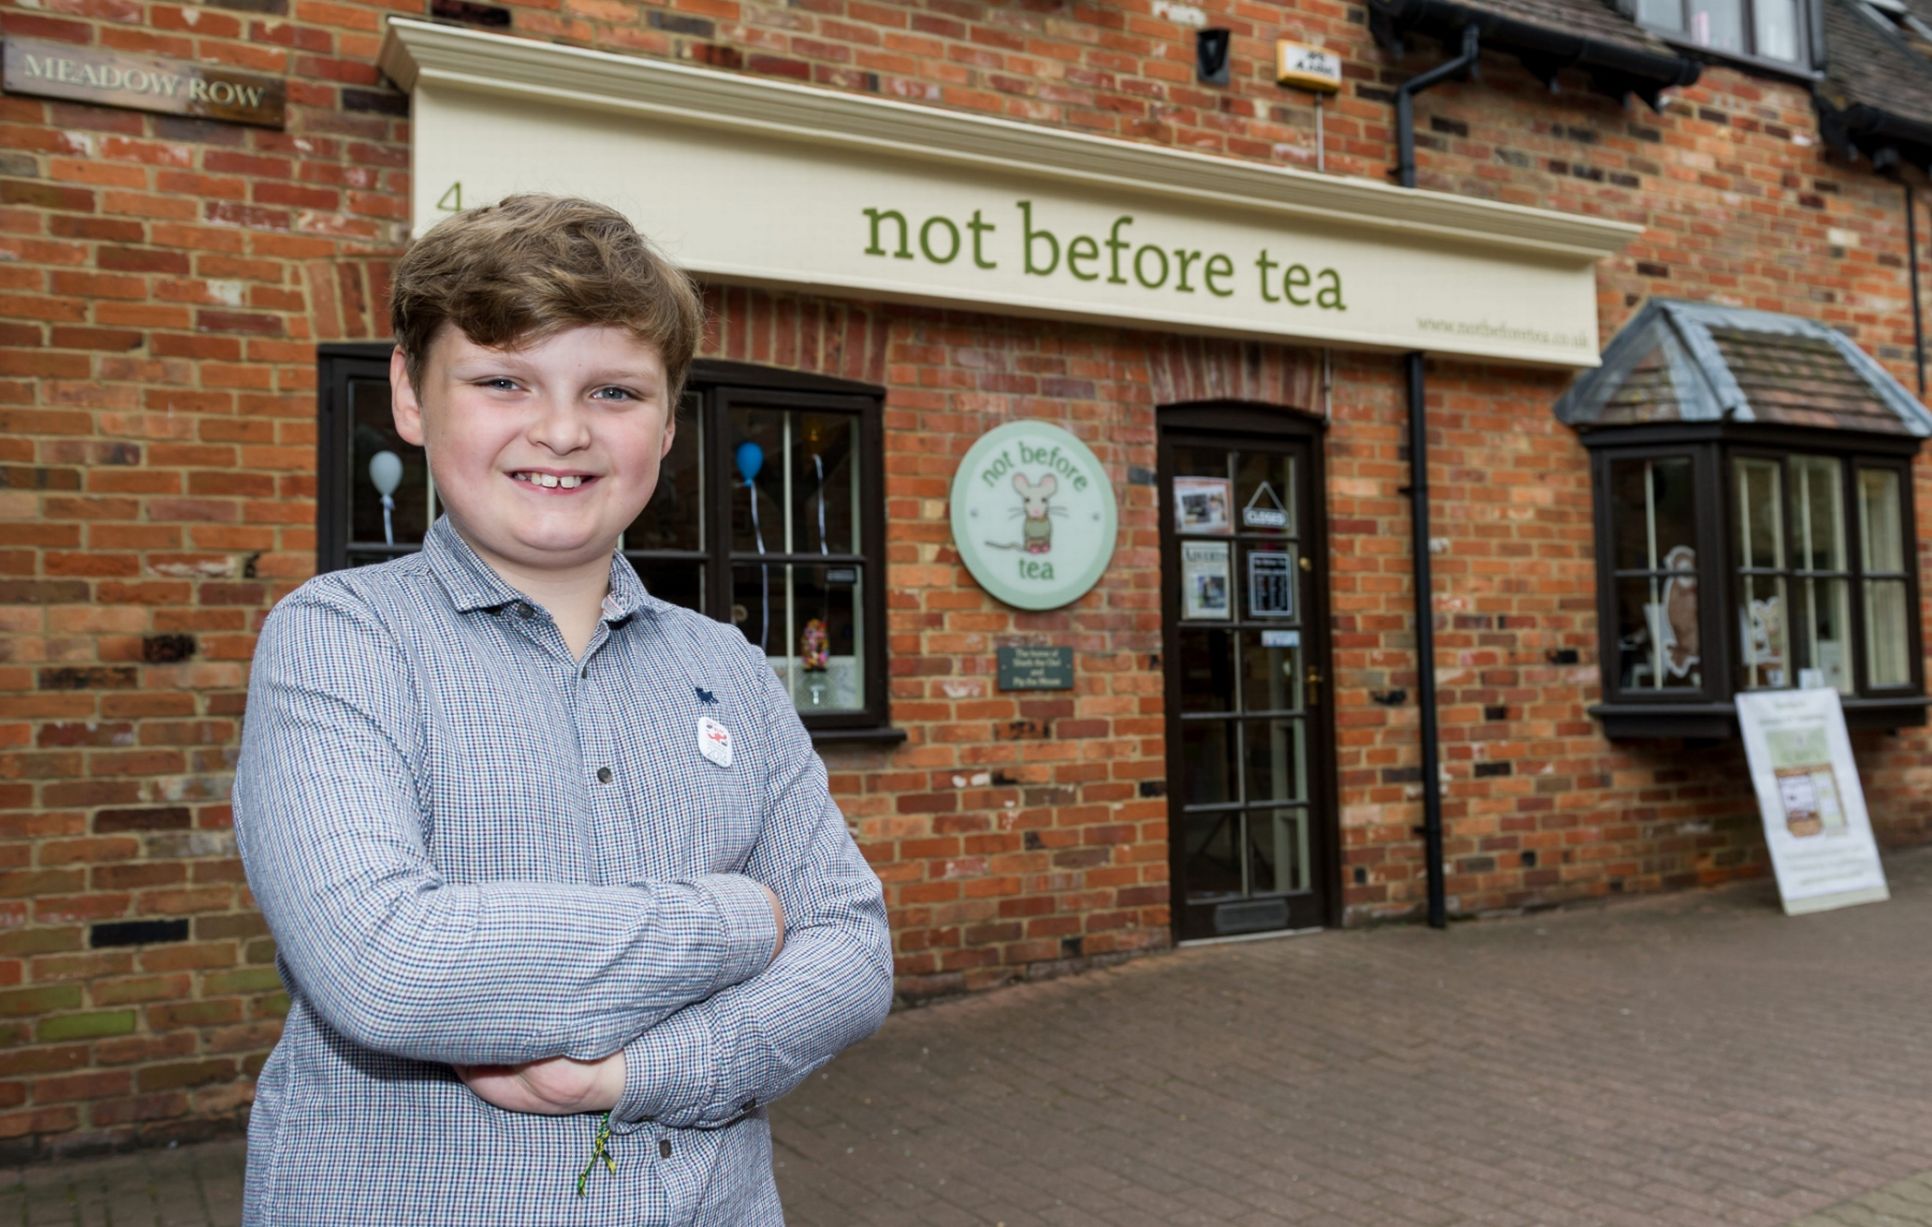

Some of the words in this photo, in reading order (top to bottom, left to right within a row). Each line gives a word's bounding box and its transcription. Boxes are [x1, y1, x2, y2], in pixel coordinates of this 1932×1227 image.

[24, 54, 180, 97] MEADOW
[188, 77, 265, 108] ROW
[436, 181, 464, 212] 4
[862, 206, 997, 270] not
[1016, 200, 1235, 297] before
[1255, 248, 1347, 312] tea
[981, 450, 1015, 488] not
[1018, 440, 1089, 493] before
[1018, 557, 1055, 581] tea
